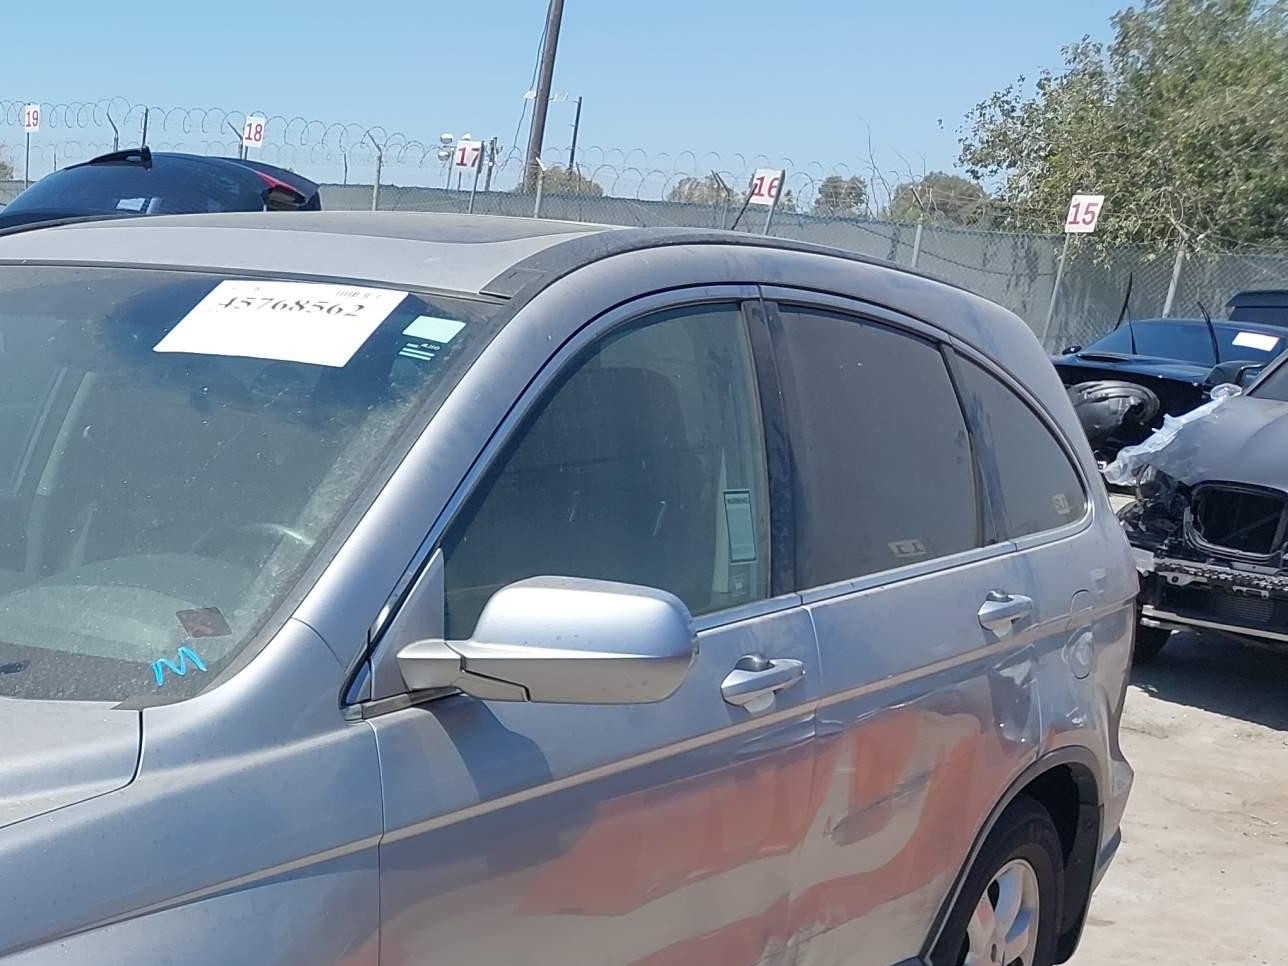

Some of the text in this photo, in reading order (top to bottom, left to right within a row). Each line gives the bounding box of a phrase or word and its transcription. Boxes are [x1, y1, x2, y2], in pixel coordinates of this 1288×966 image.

[25, 110, 39, 127] 19
[244, 122, 263, 142] 18
[455, 147, 481, 168] 17
[1068, 202, 1099, 225] 15
[217, 296, 366, 318] 45768562
